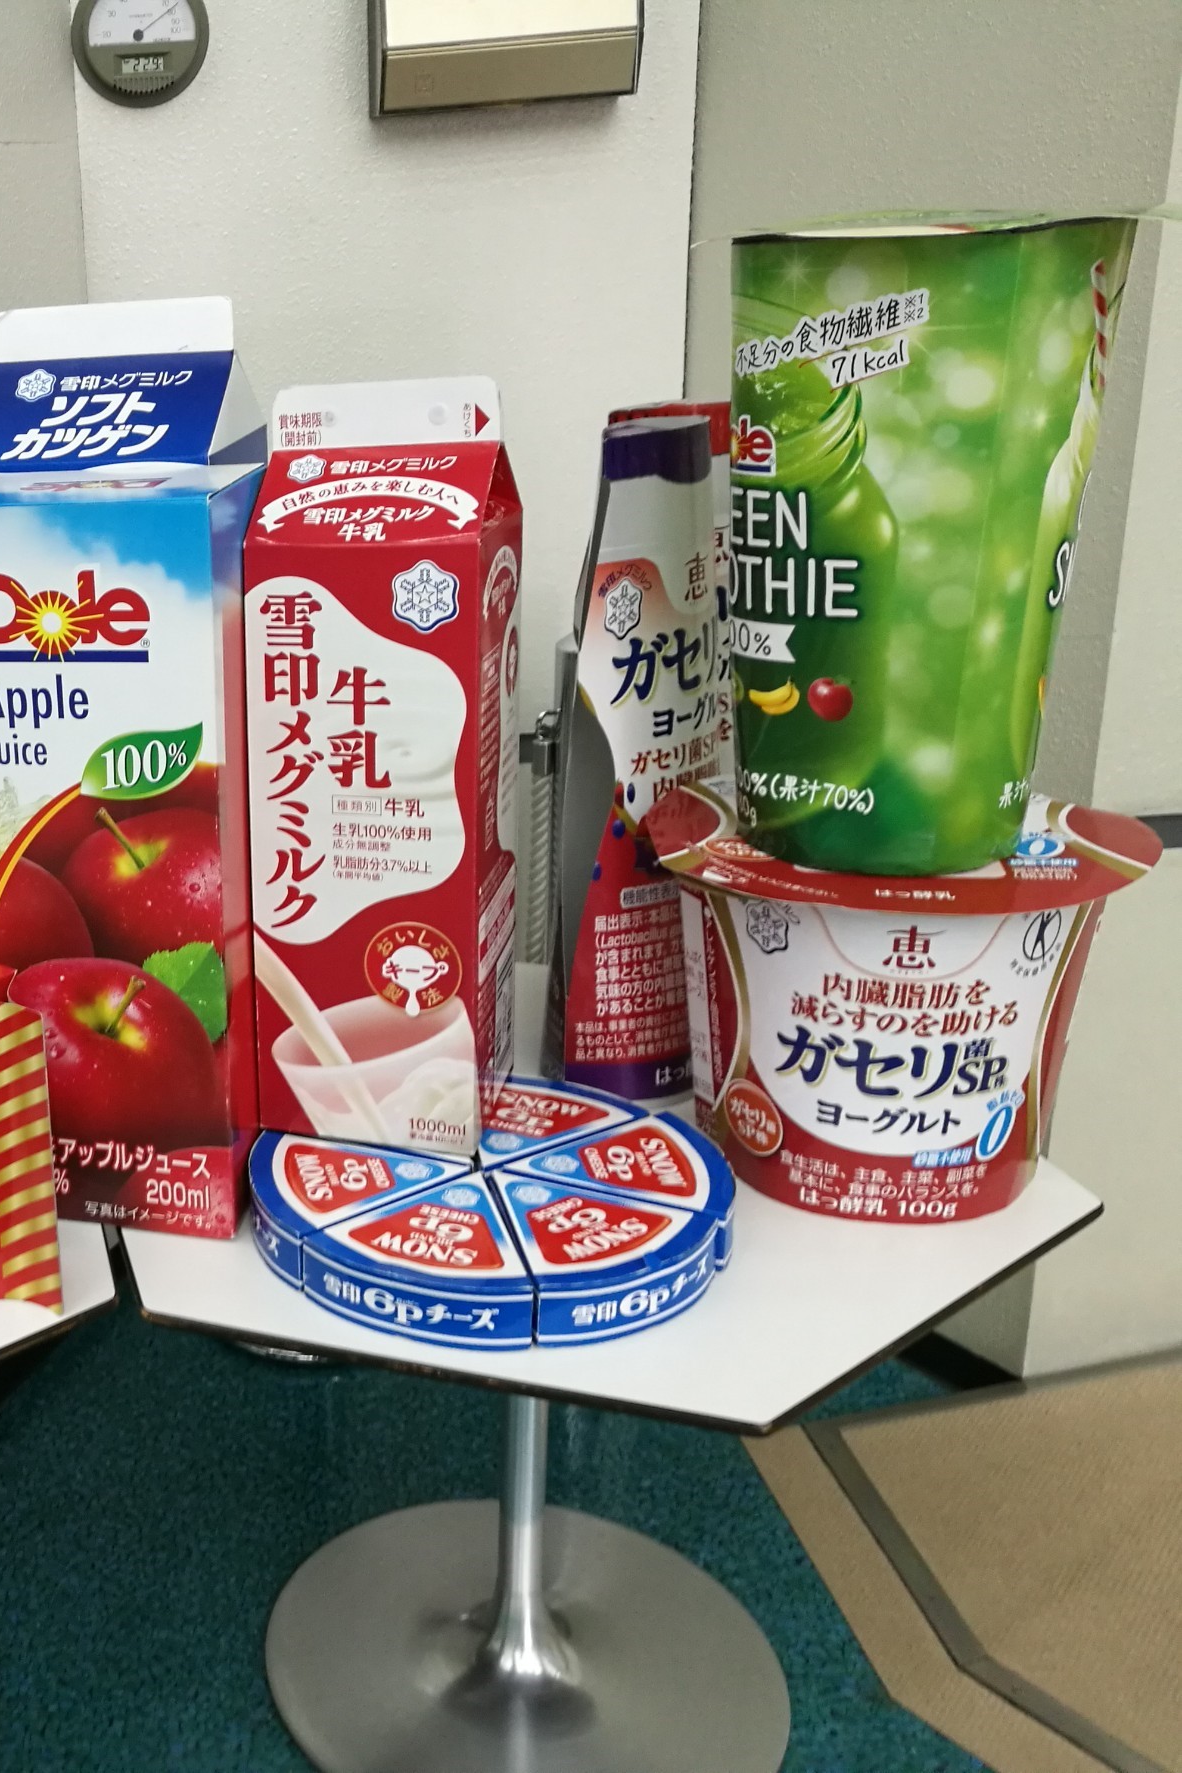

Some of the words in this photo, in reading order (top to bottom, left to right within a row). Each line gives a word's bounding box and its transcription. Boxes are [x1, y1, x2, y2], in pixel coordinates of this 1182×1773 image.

[736, 300, 901, 370] 不足分の食物繊維
[831, 340, 905, 383] 71kcal
[59, 370, 193, 392] 雪印メグミルク
[39, 391, 157, 428] ソフト
[279, 411, 323, 430] 賞味期限
[463, 403, 472, 437] あけくち
[0, 424, 169, 460] カツゲン
[280, 430, 322, 447] (開封前)
[330, 456, 458, 475] 雪印メグミルク
[282, 479, 459, 511] 自然の恵みを楽しむ人へ
[303, 505, 436, 525] 雪印メグミルク
[338, 522, 386, 542] 牛乳
[730, 485, 807, 550] EEN
[598, 562, 653, 599] 雪印メグミルク
[684, 551, 709, 602] 恵
[611, 616, 716, 705] ガセリ
[326, 666, 392, 789] 牛乳
[100, 740, 188, 792] 100%
[260, 591, 326, 928] 雪印メグミルク
[336, 799, 377, 813] 種類別
[384, 798, 425, 818] 牛乳
[332, 822, 432, 842] 生乳100%使用
[332, 838, 391, 852] 成分無調整
[332, 856, 433, 875] 乳脂肪分3.7%以上
[376, 929, 450, 958] おいしさ
[882, 924, 948, 970] 恵
[384, 959, 449, 982] キープ
[821, 973, 992, 1011] 内臓脂肪を
[791, 991, 1019, 1037] 減らすのを助ける
[500, 1090, 588, 1117] SNOW
[816, 1099, 961, 1137] ヨーグルト
[408, 1117, 467, 1136] 1000ml
[52, 1138, 212, 1180] アップルジュース
[294, 1153, 333, 1200] SNOW
[640, 1137, 687, 1188] SNOW
[146, 1179, 212, 1211] 200ml
[800, 1187, 887, 1217] はっ酵乳
[897, 1200, 958, 1218] 100g
[84, 1200, 212, 1230] 写真はイメージです。
[370, 1231, 478, 1266] SNOW
[562, 1217, 649, 1261] SNOW
